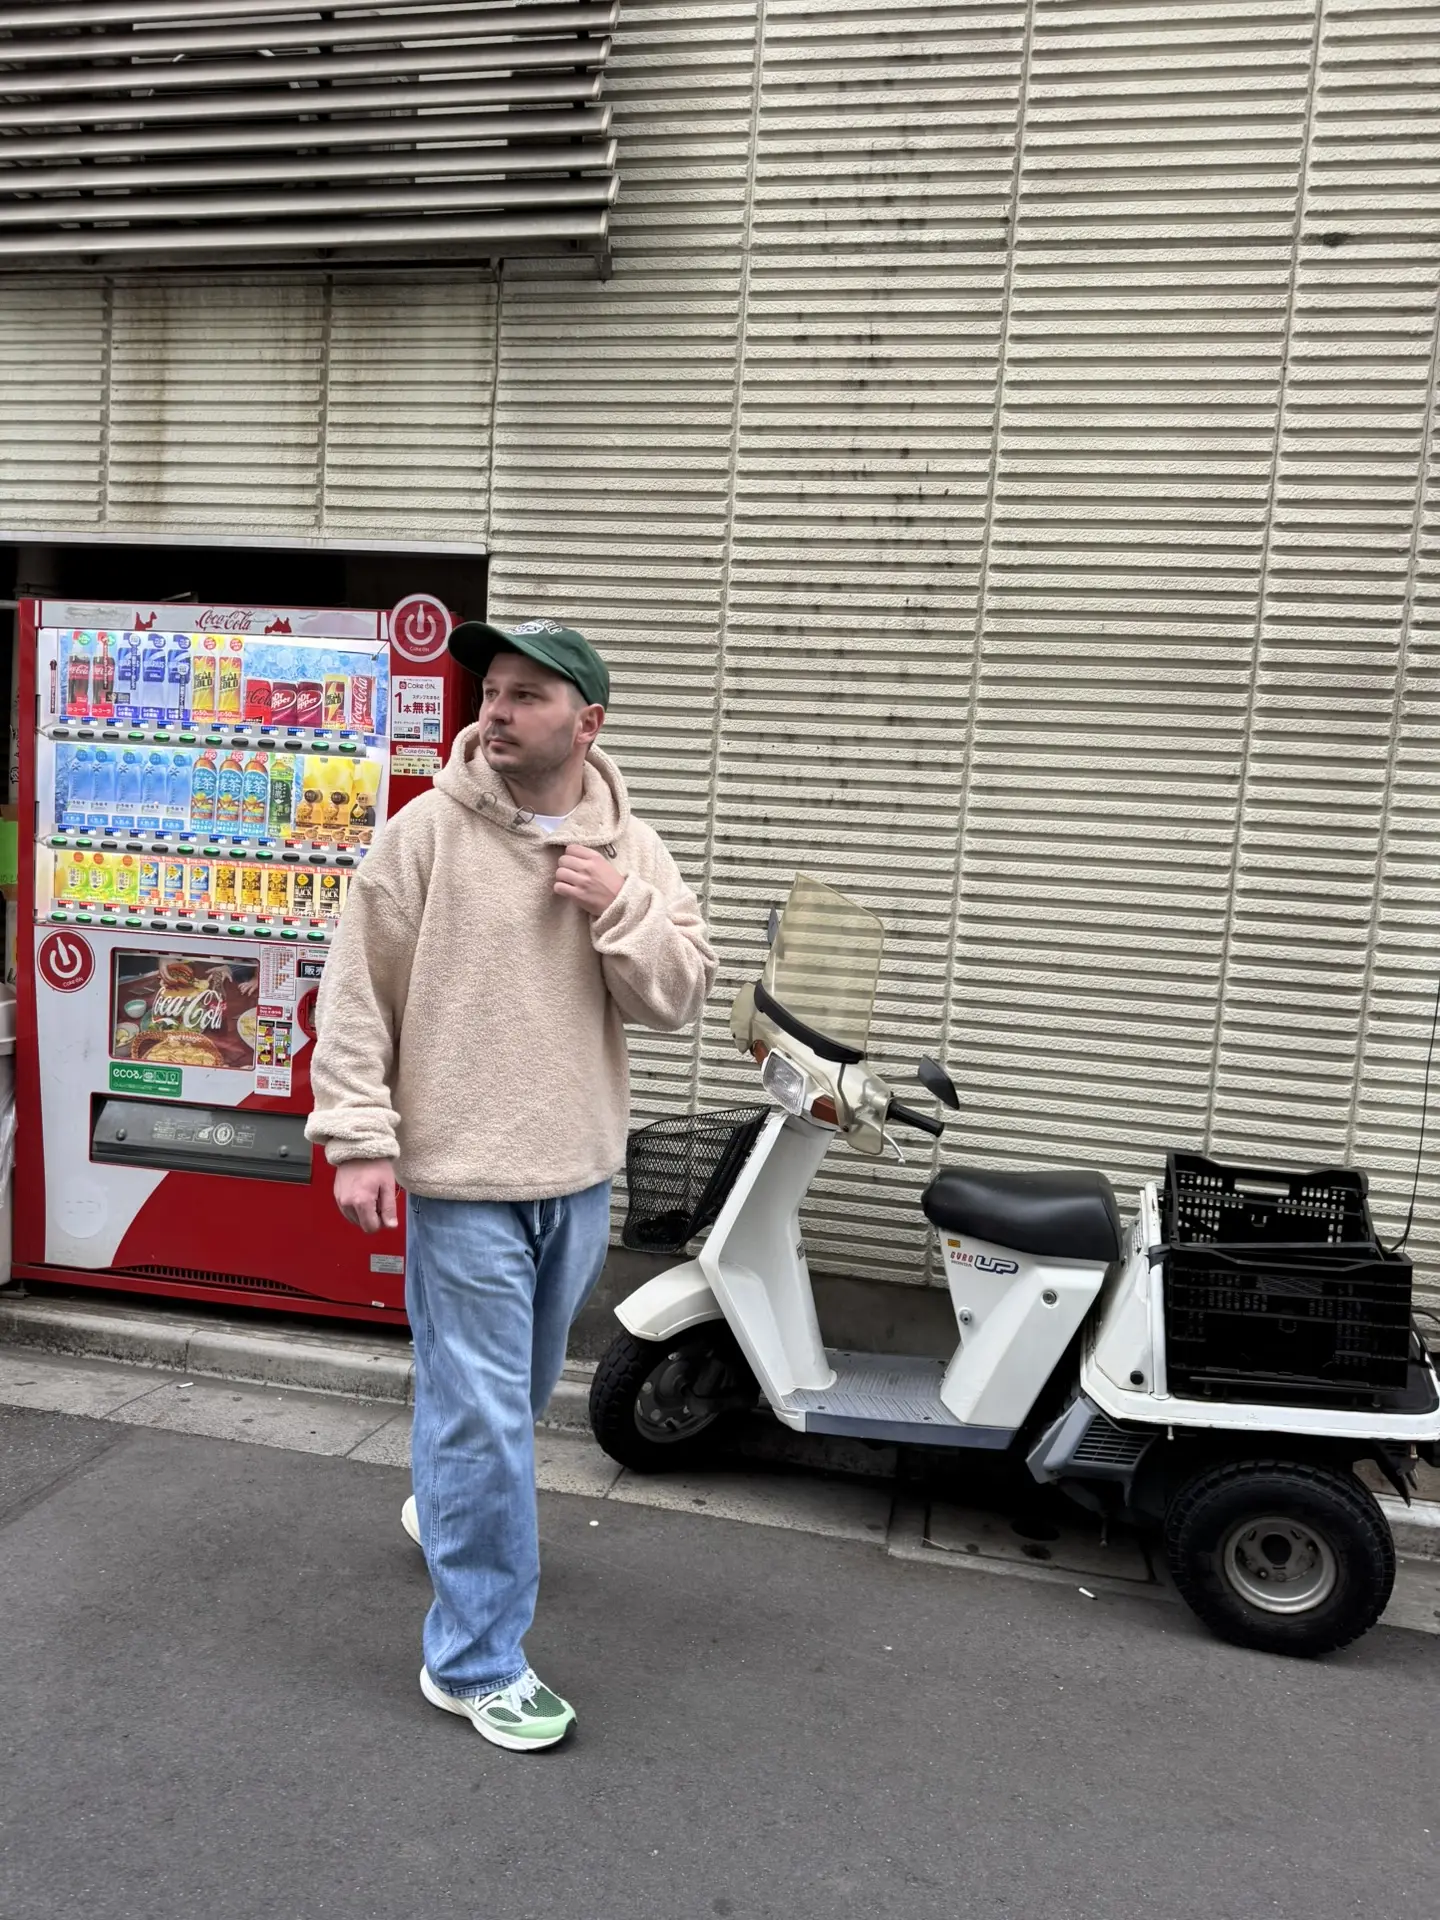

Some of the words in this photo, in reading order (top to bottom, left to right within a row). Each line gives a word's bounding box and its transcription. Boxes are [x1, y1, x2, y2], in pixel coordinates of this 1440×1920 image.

[195, 609, 254, 631] Coca-Cola
[273, 692, 284, 700] Dr
[299, 693, 310, 701] Dr
[352, 677, 368, 724] Coca-Cola
[152, 986, 223, 1030] Coca-Cola
[974, 1254, 1019, 1275] UP
